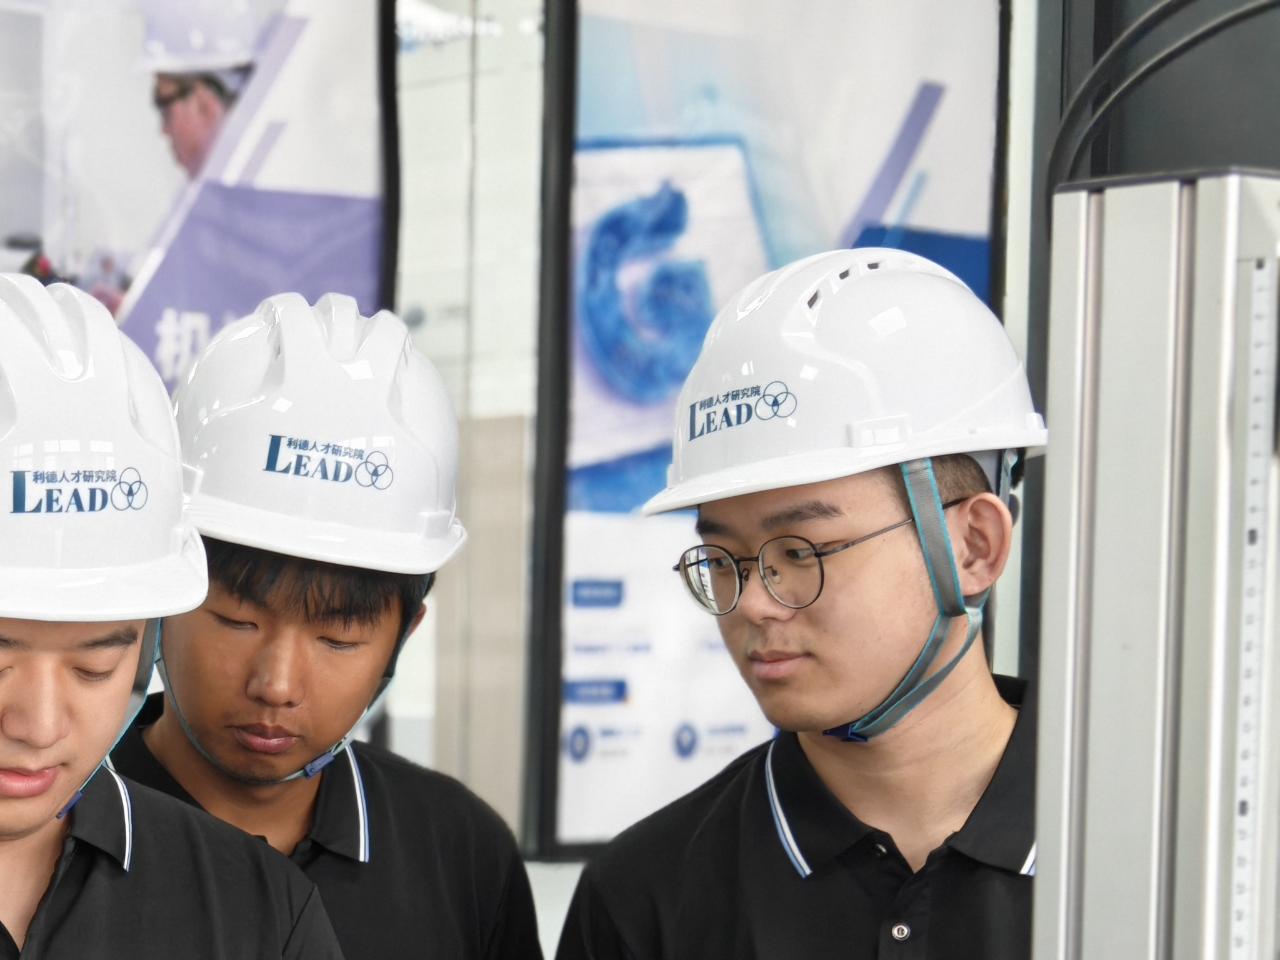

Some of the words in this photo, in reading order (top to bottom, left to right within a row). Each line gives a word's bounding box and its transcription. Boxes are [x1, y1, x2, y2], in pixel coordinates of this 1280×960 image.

[689, 401, 753, 441] LEAD
[33, 470, 117, 484] 利德人才研究院
[263, 434, 353, 482] LEAD
[10, 470, 109, 513] LEAD
